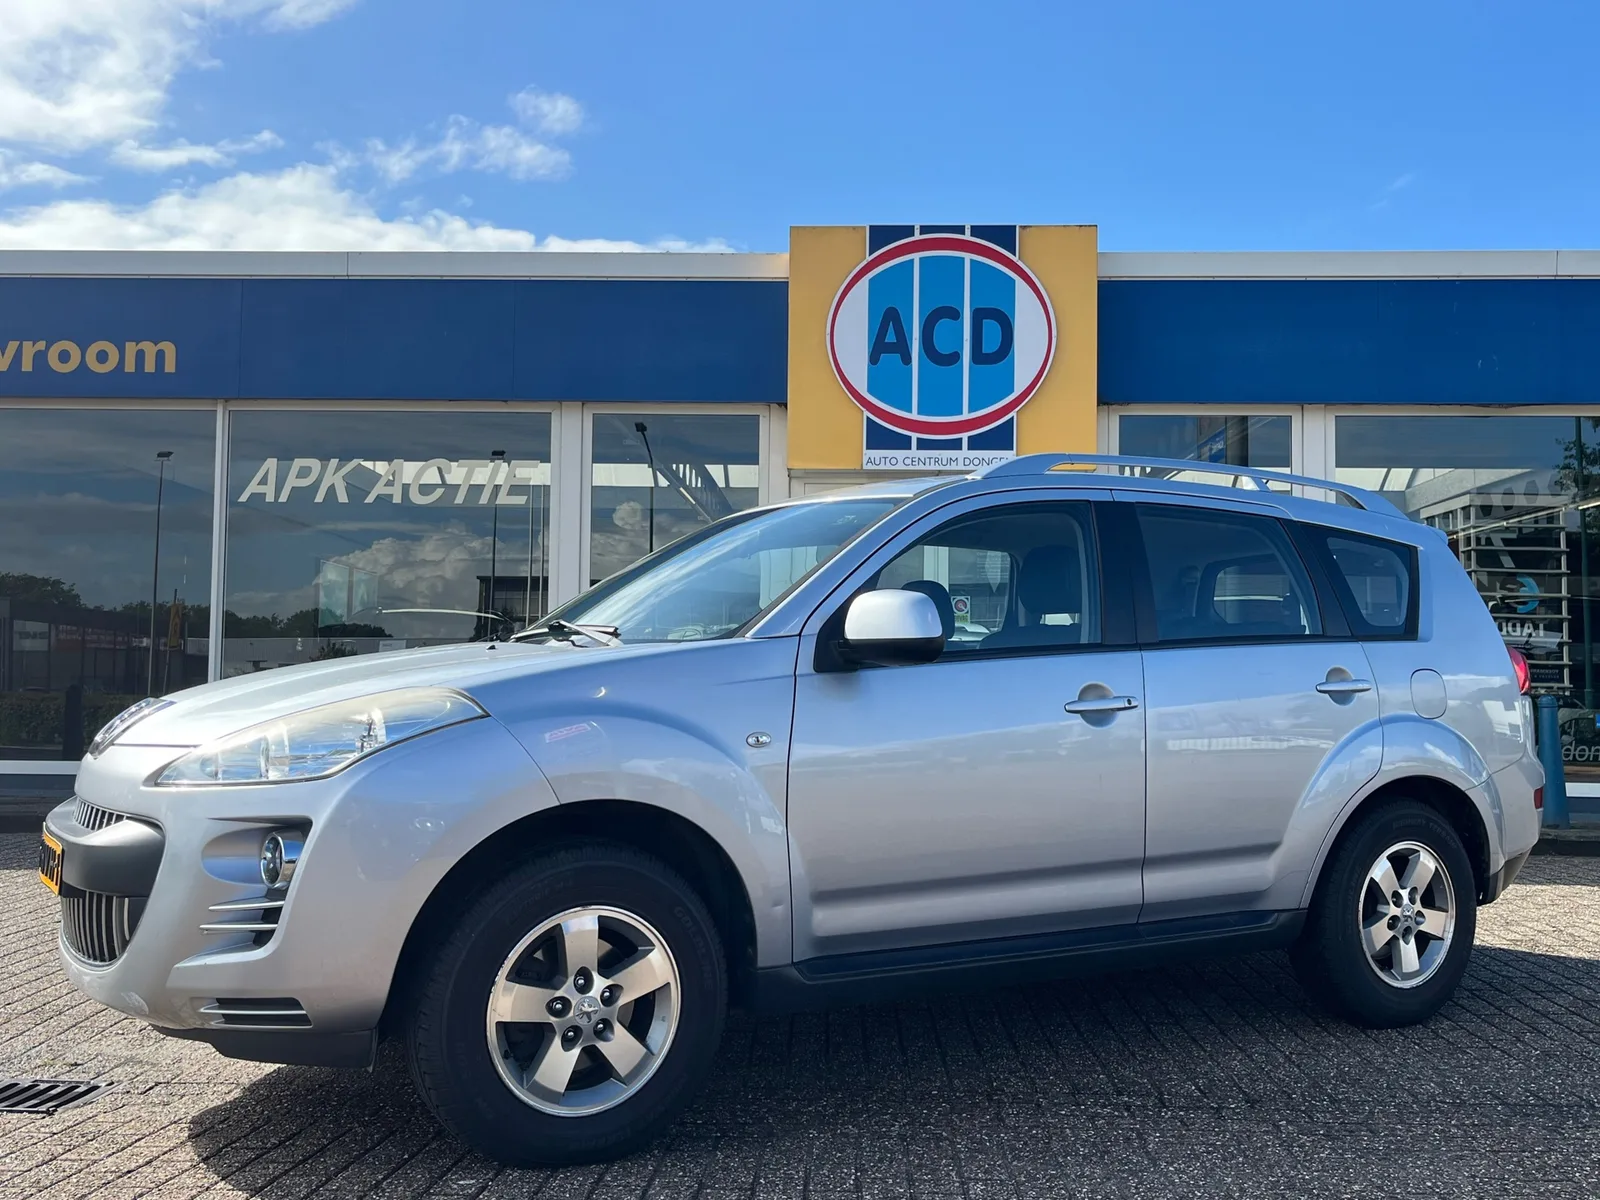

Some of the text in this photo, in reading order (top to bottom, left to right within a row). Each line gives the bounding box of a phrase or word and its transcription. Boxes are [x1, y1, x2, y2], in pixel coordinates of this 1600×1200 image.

[869, 306, 1014, 367] ACD
[237, 457, 541, 505] APK ACTIE
[865, 456, 1009, 467] AUTO CENTRUM DONG
